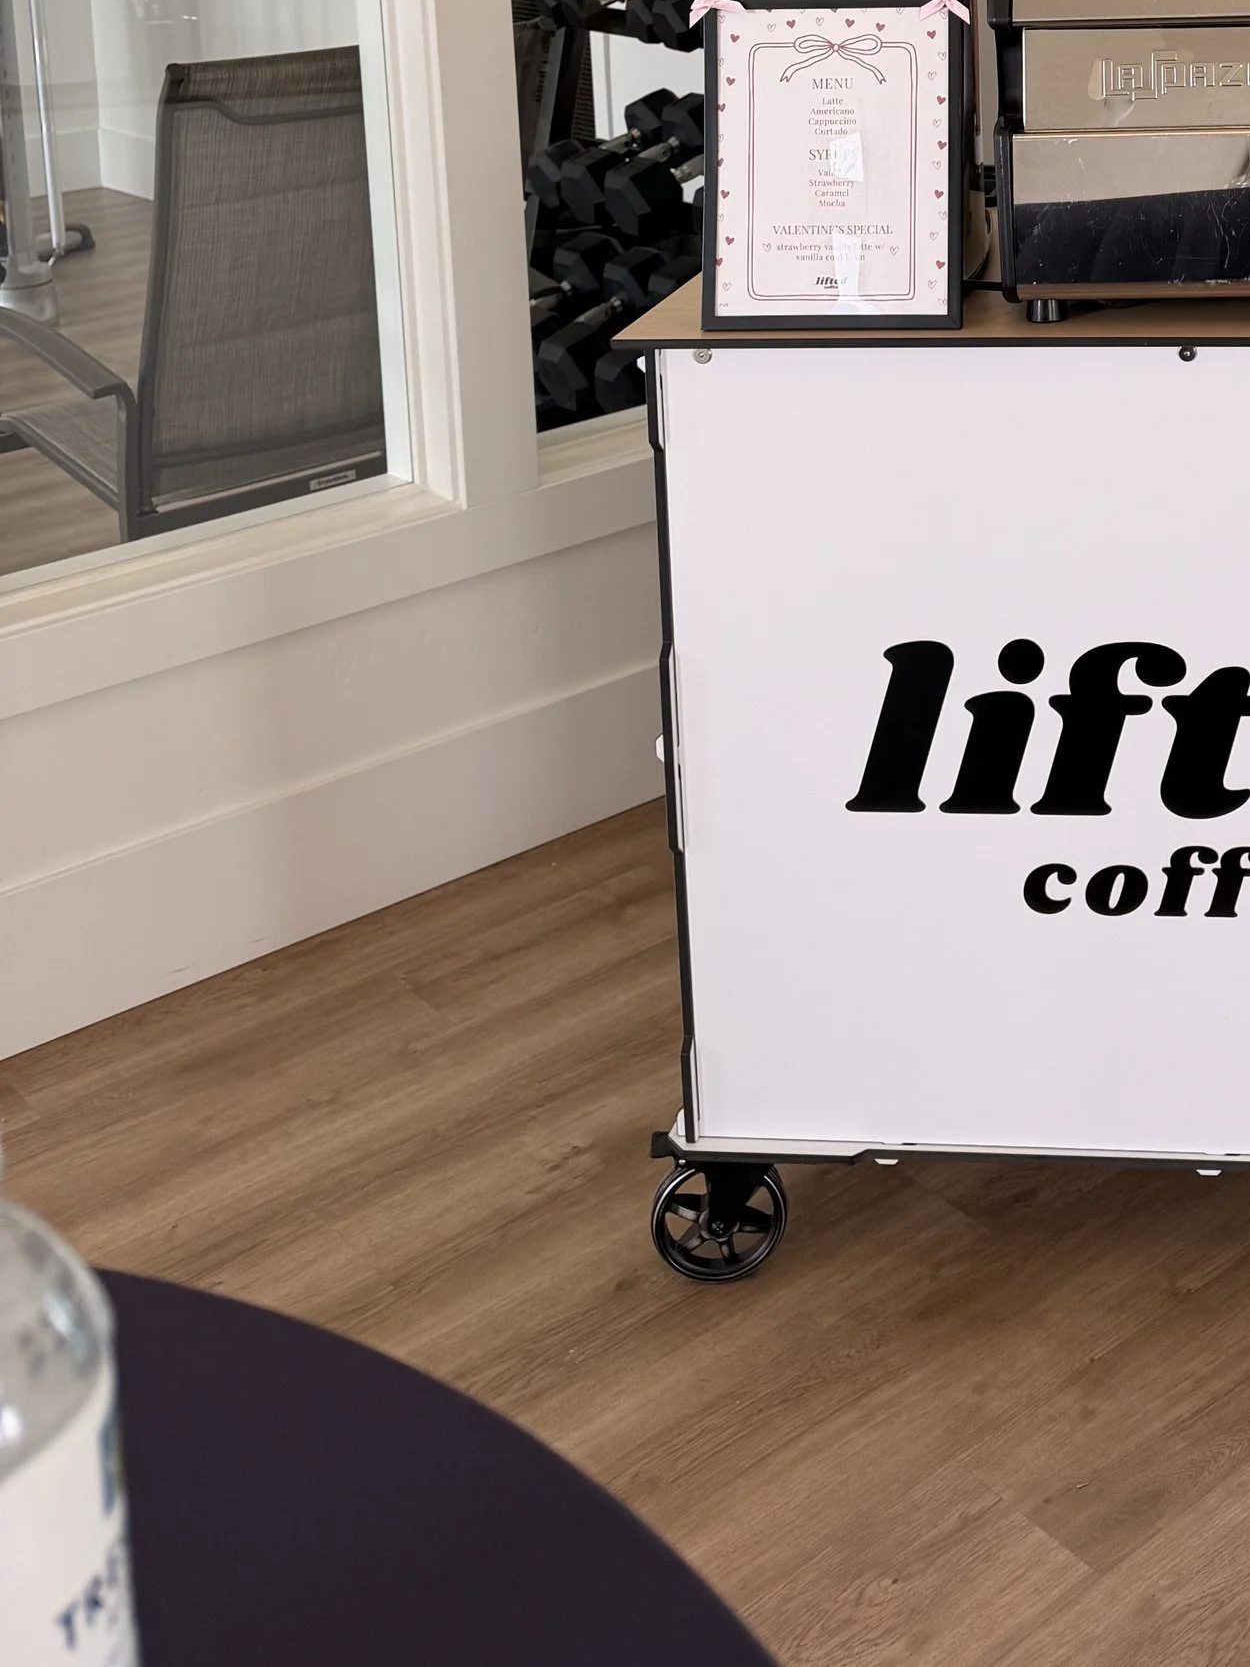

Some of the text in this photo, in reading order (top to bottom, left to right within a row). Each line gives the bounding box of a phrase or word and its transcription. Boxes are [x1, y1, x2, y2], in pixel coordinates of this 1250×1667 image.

[812, 77, 854, 90] MENU
[822, 97, 844, 105] Latte
[809, 107, 855, 115] Americano
[808, 117, 857, 127] Cappuccino
[814, 127, 848, 136] Cortado
[808, 179, 855, 188] Strawberry
[814, 189, 849, 197] Caramel
[846, 224, 893, 235] SPECIAL
[776, 242, 822, 252] strawberry
[795, 253, 823, 261] vanilla
[825, 253, 844, 261] cod
